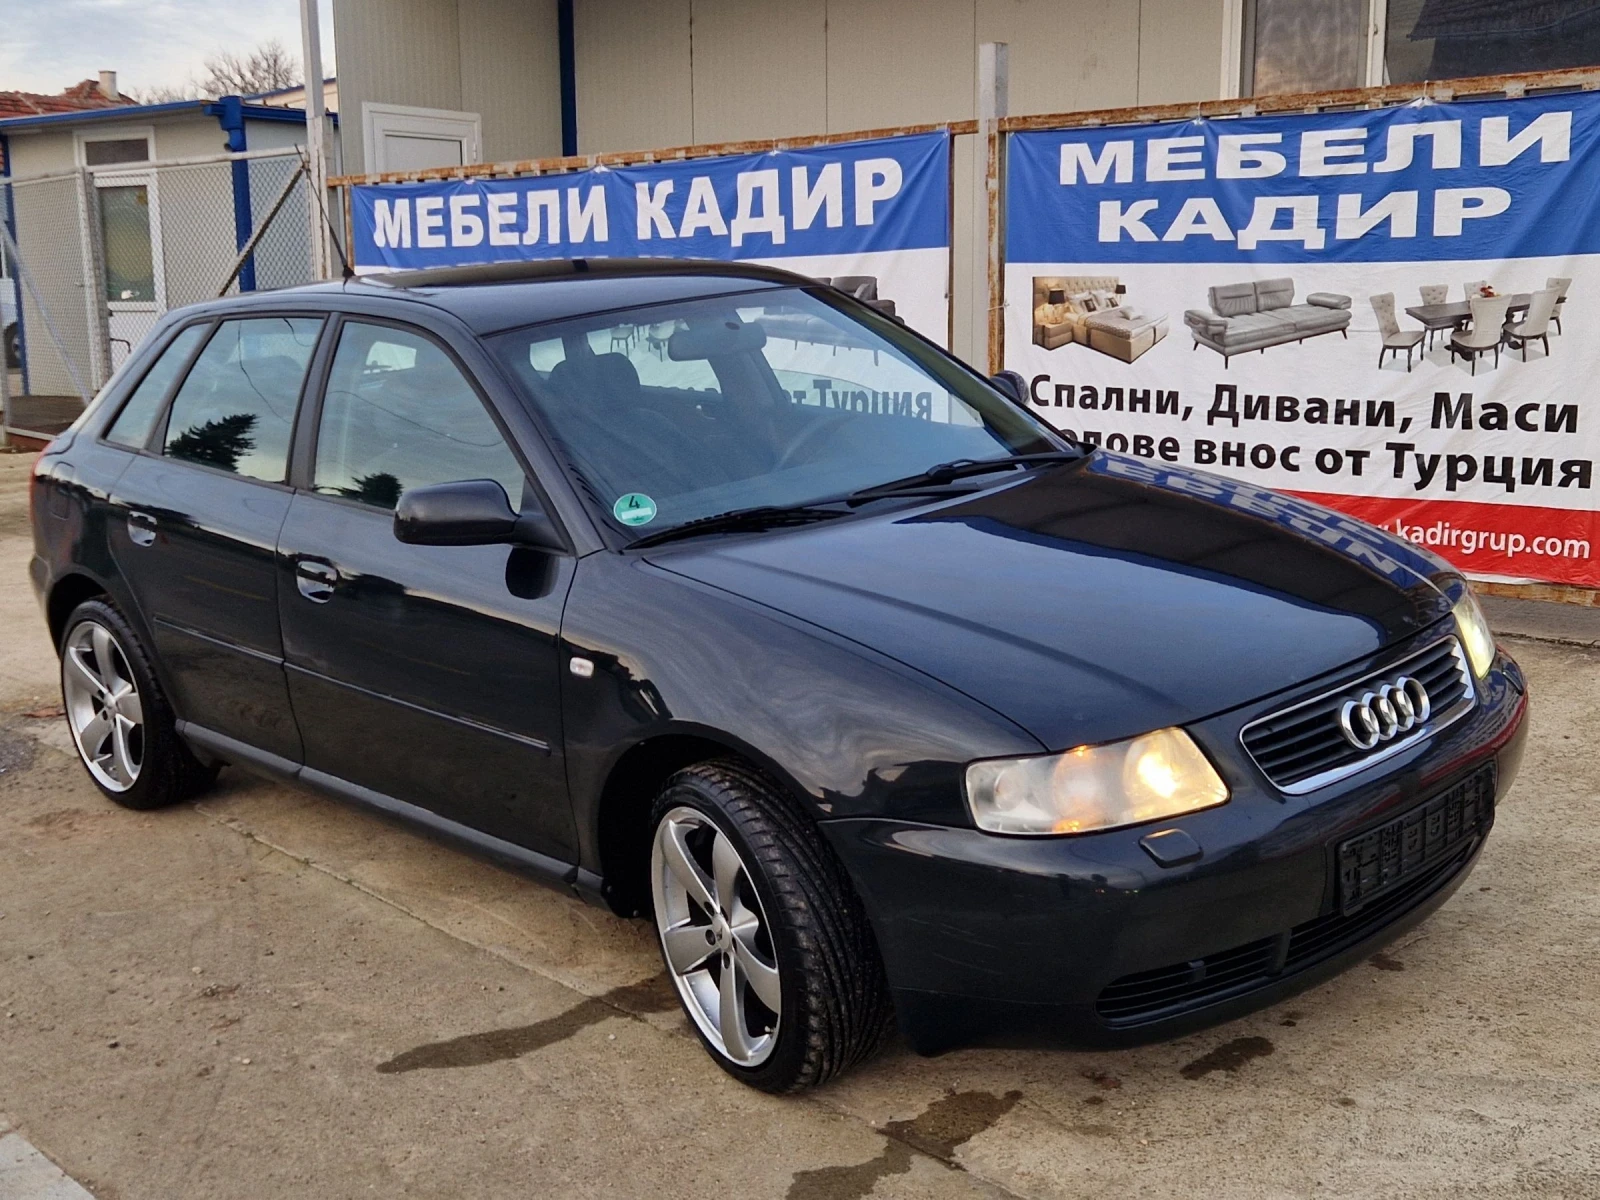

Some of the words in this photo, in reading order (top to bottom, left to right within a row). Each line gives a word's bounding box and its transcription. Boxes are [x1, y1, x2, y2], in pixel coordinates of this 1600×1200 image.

[1059, 110, 1573, 186] МЕБЕЛИ
[373, 184, 609, 249] МЕБЕЛИ
[635, 157, 903, 247] КАДИР
[1098, 186, 1512, 251] КАДИР
[1030, 374, 1194, 422] Спални,
[1207, 383, 1413, 435] Дивани,
[1430, 391, 1579, 434] Маси
[1193, 438, 1301, 472] внос
[1315, 446, 1370, 478] от
[1385, 442, 1593, 492] Турция
[628, 495, 641, 509] 4
[1378, 518, 1591, 560] kadirgrup.com
